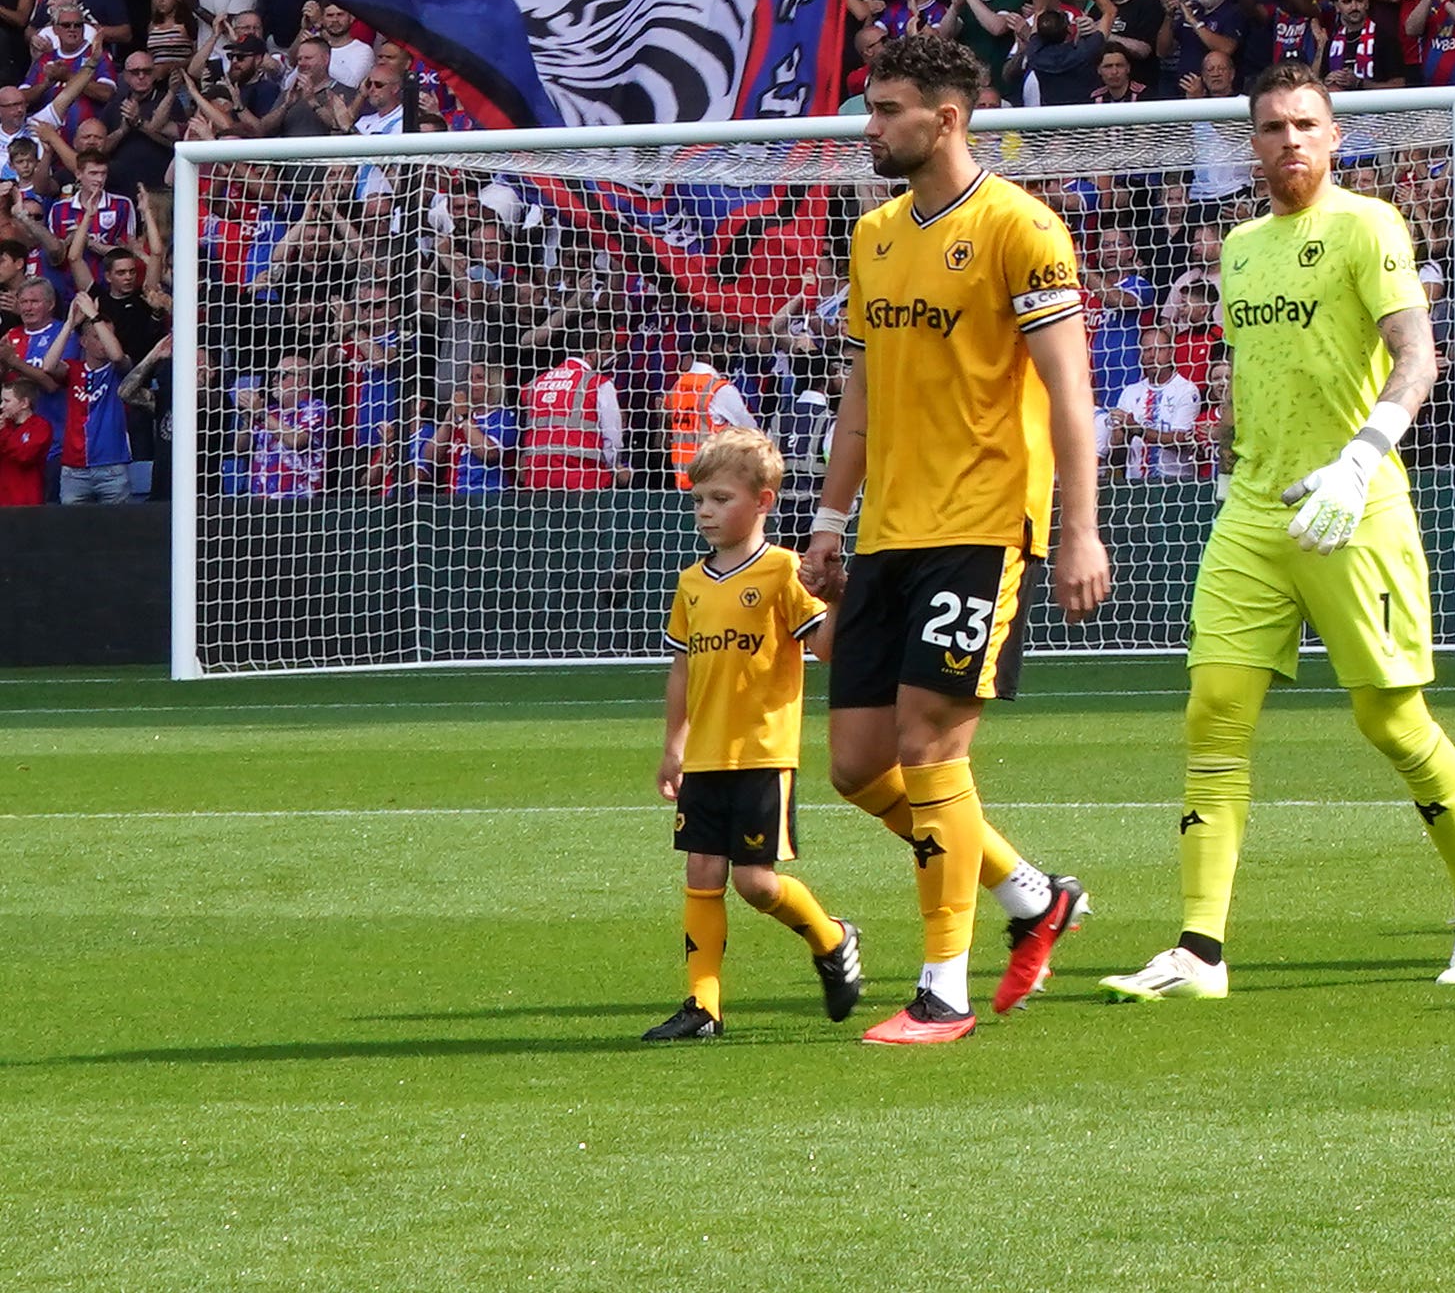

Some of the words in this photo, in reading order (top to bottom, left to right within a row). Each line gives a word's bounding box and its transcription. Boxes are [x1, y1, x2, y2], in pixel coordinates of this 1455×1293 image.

[1431, 38, 1455, 51] W88
[420, 73, 440, 85] DK
[88, 234, 108, 244] DK
[866, 298, 963, 340] AstroPay
[921, 591, 993, 652] 23
[1380, 593, 1391, 632] 1
